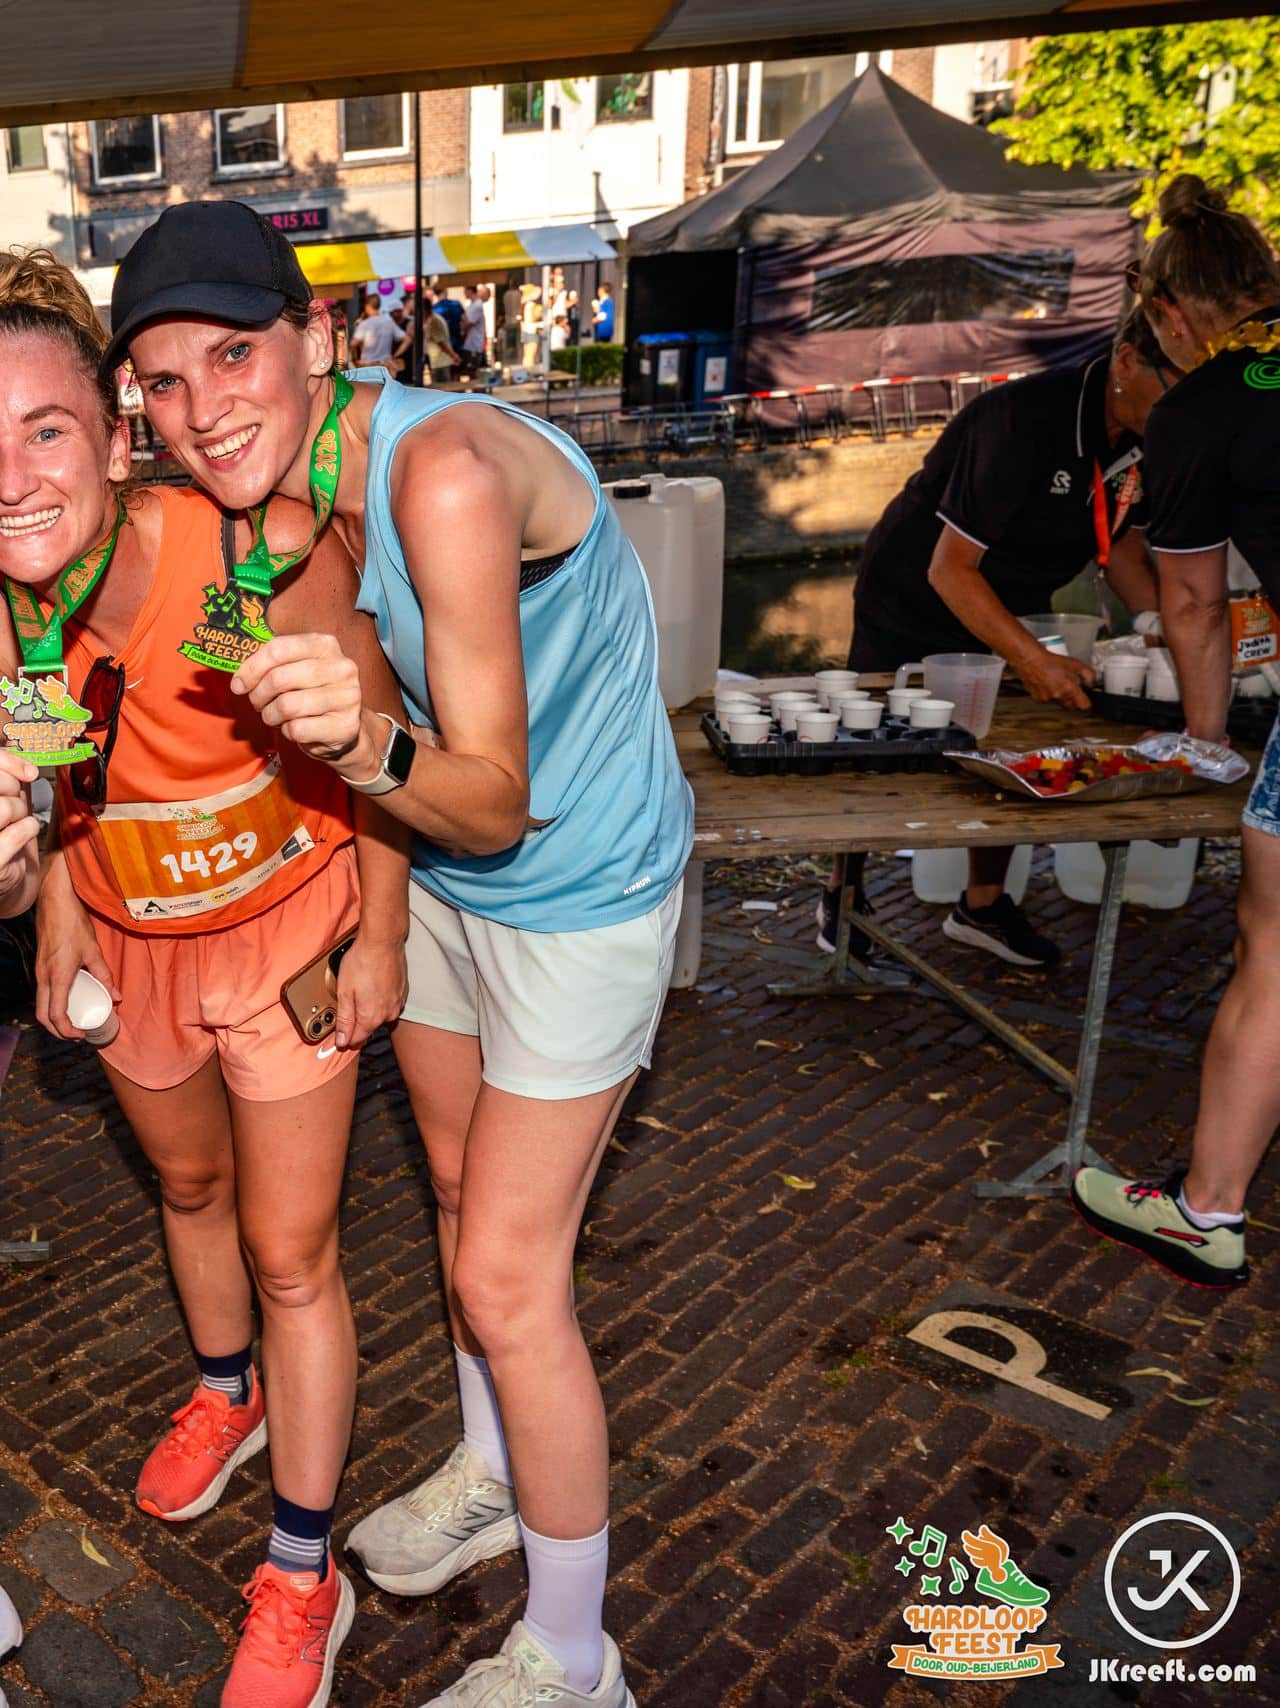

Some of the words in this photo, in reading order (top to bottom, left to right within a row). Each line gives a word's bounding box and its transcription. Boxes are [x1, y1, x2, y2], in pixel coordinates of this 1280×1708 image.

[302, 210, 320, 226] XL
[315, 429, 337, 476] 2026
[196, 625, 262, 653] HARDLOO
[205, 642, 251, 663] FEEST
[160, 831, 258, 884] 1429
[906, 1310, 1113, 1421] P
